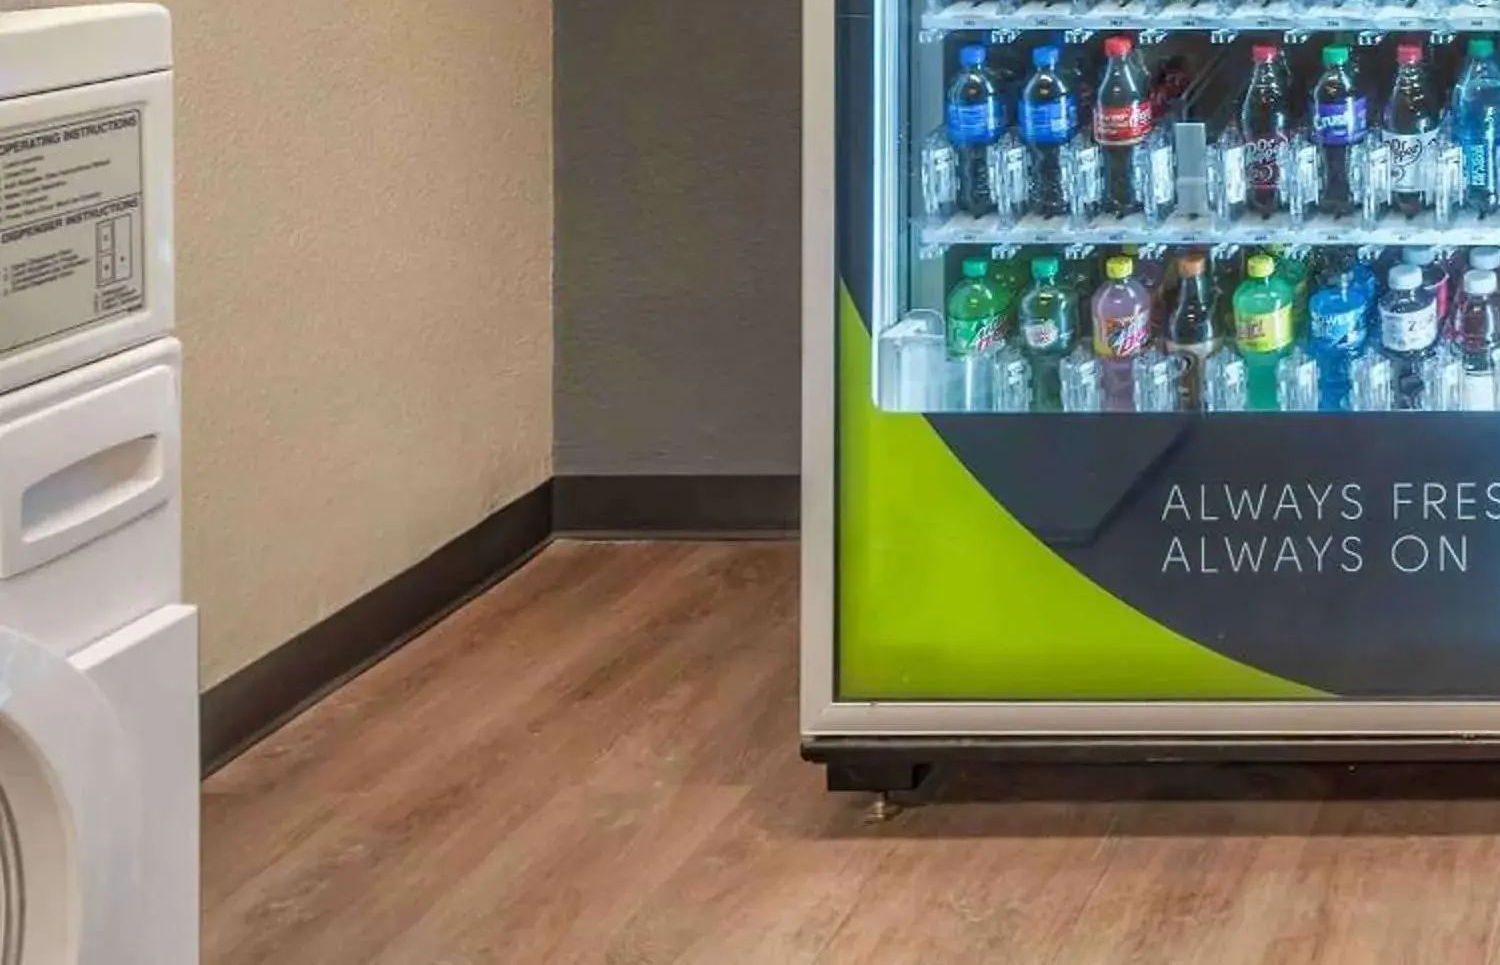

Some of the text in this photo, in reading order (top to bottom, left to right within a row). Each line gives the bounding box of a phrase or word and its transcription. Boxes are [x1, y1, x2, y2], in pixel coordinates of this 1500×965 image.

[63, 117, 137, 141] INSTRUCTIONS
[65, 198, 139, 226] INSTRUCTIONS
[1160, 483, 1364, 522] ALWAYS
[1160, 534, 1467, 573] ALWAYS ON
